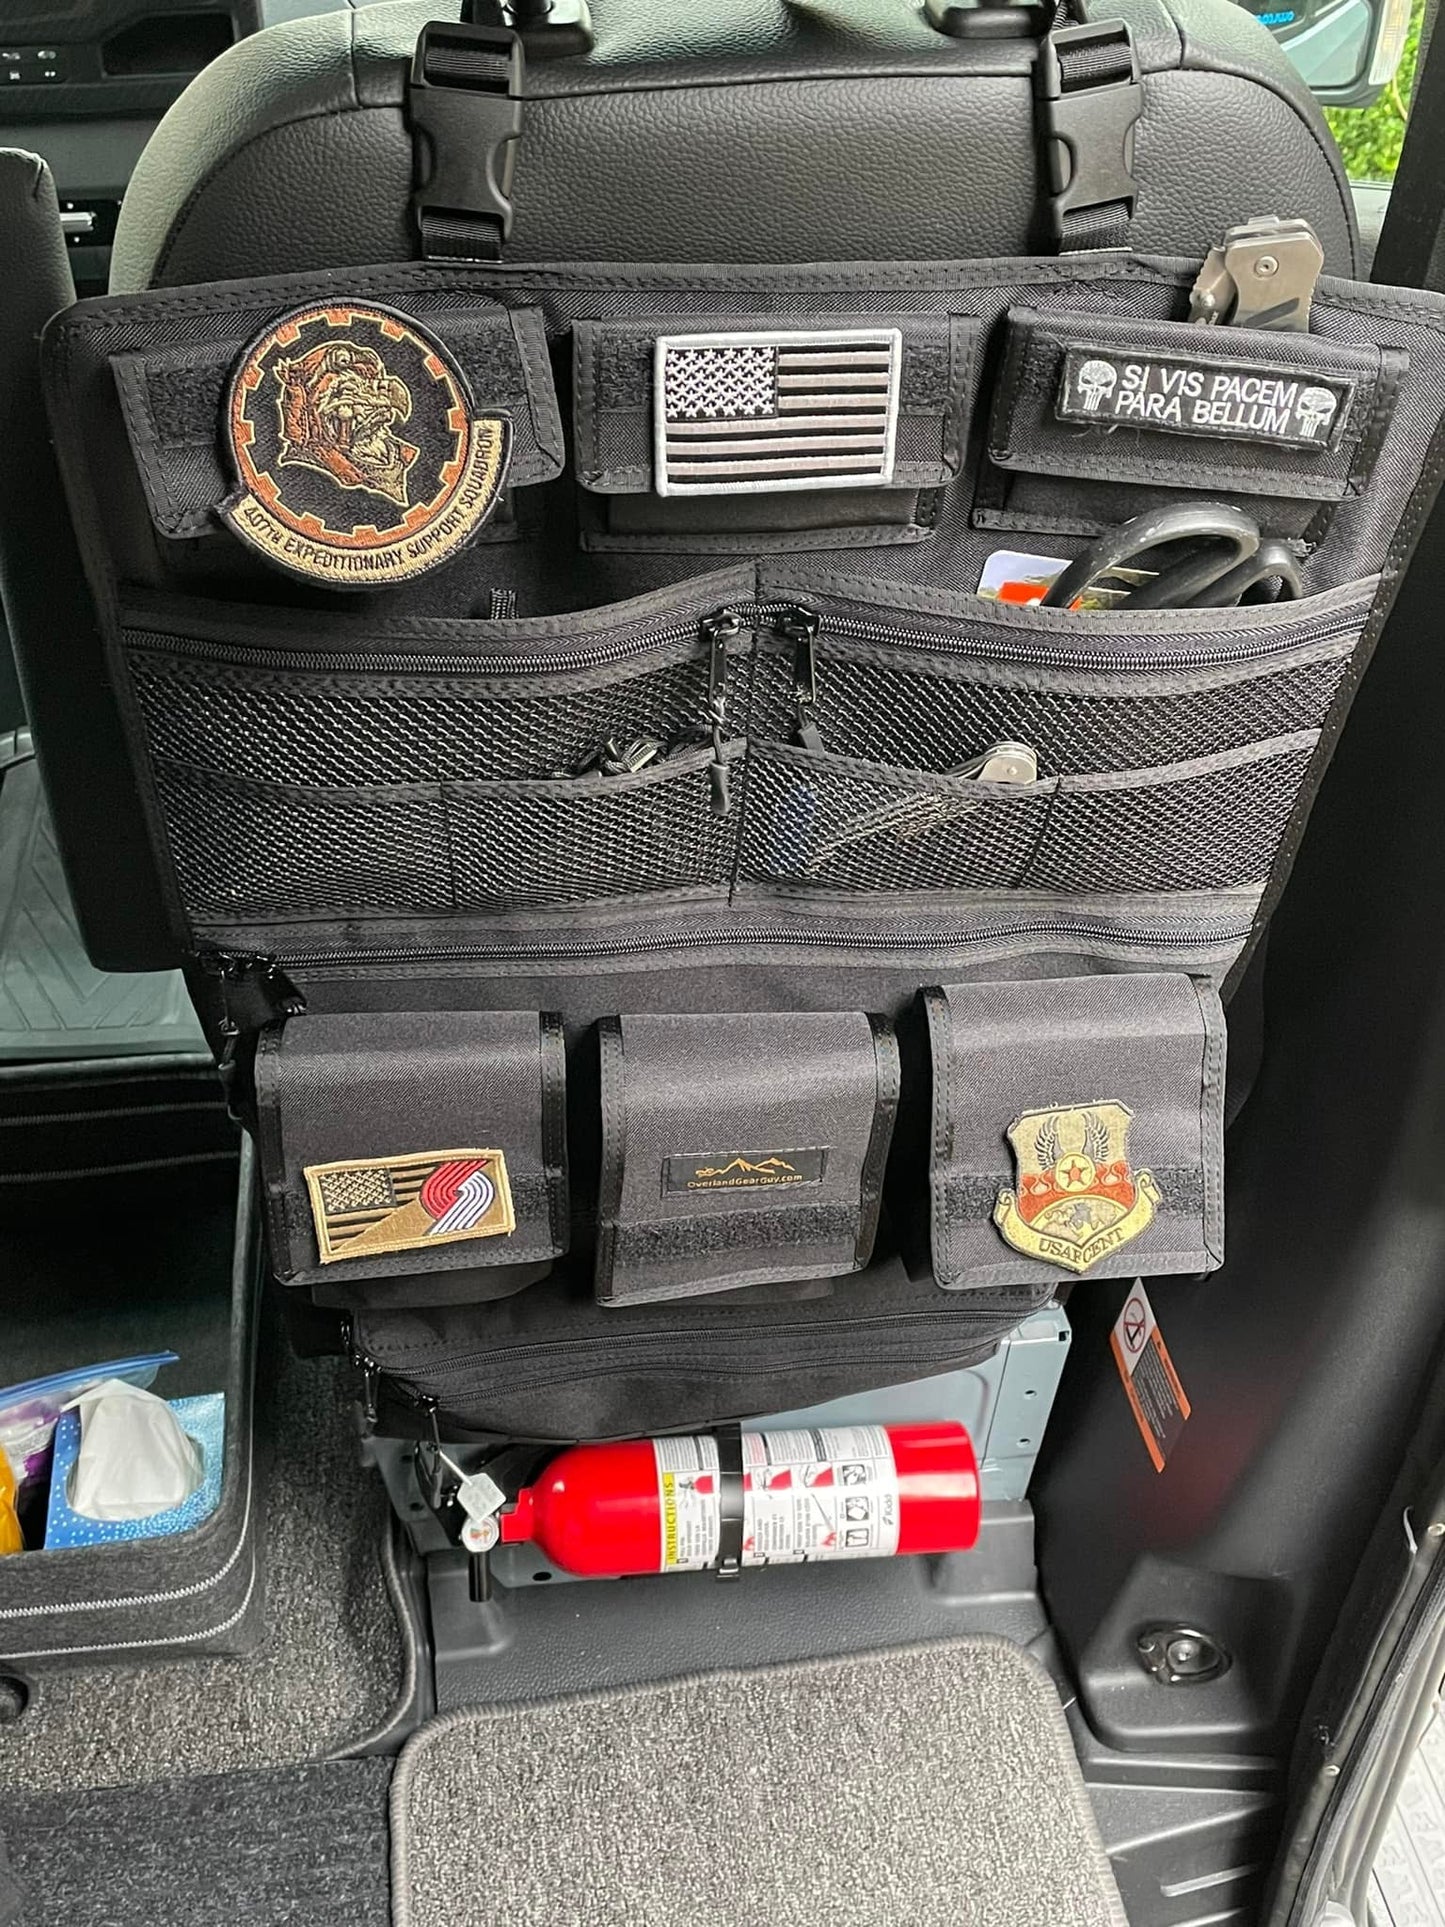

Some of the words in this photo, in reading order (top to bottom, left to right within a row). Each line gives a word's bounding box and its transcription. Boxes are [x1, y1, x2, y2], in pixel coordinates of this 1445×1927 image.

[1122, 364, 1150, 391] SI
[1160, 368, 1205, 396] VIS
[1211, 375, 1299, 408] PACEM
[1115, 390, 1182, 422] PARA
[1192, 401, 1291, 434] BELLUM
[284, 538, 404, 571] EXPEDITIONARY
[407, 510, 466, 558] SUPPORT
[460, 427, 494, 509] SQUADRON
[687, 1174, 803, 1188] OverlandGearGuy.com
[665, 1482, 676, 1560] INSTRUCTIONS
